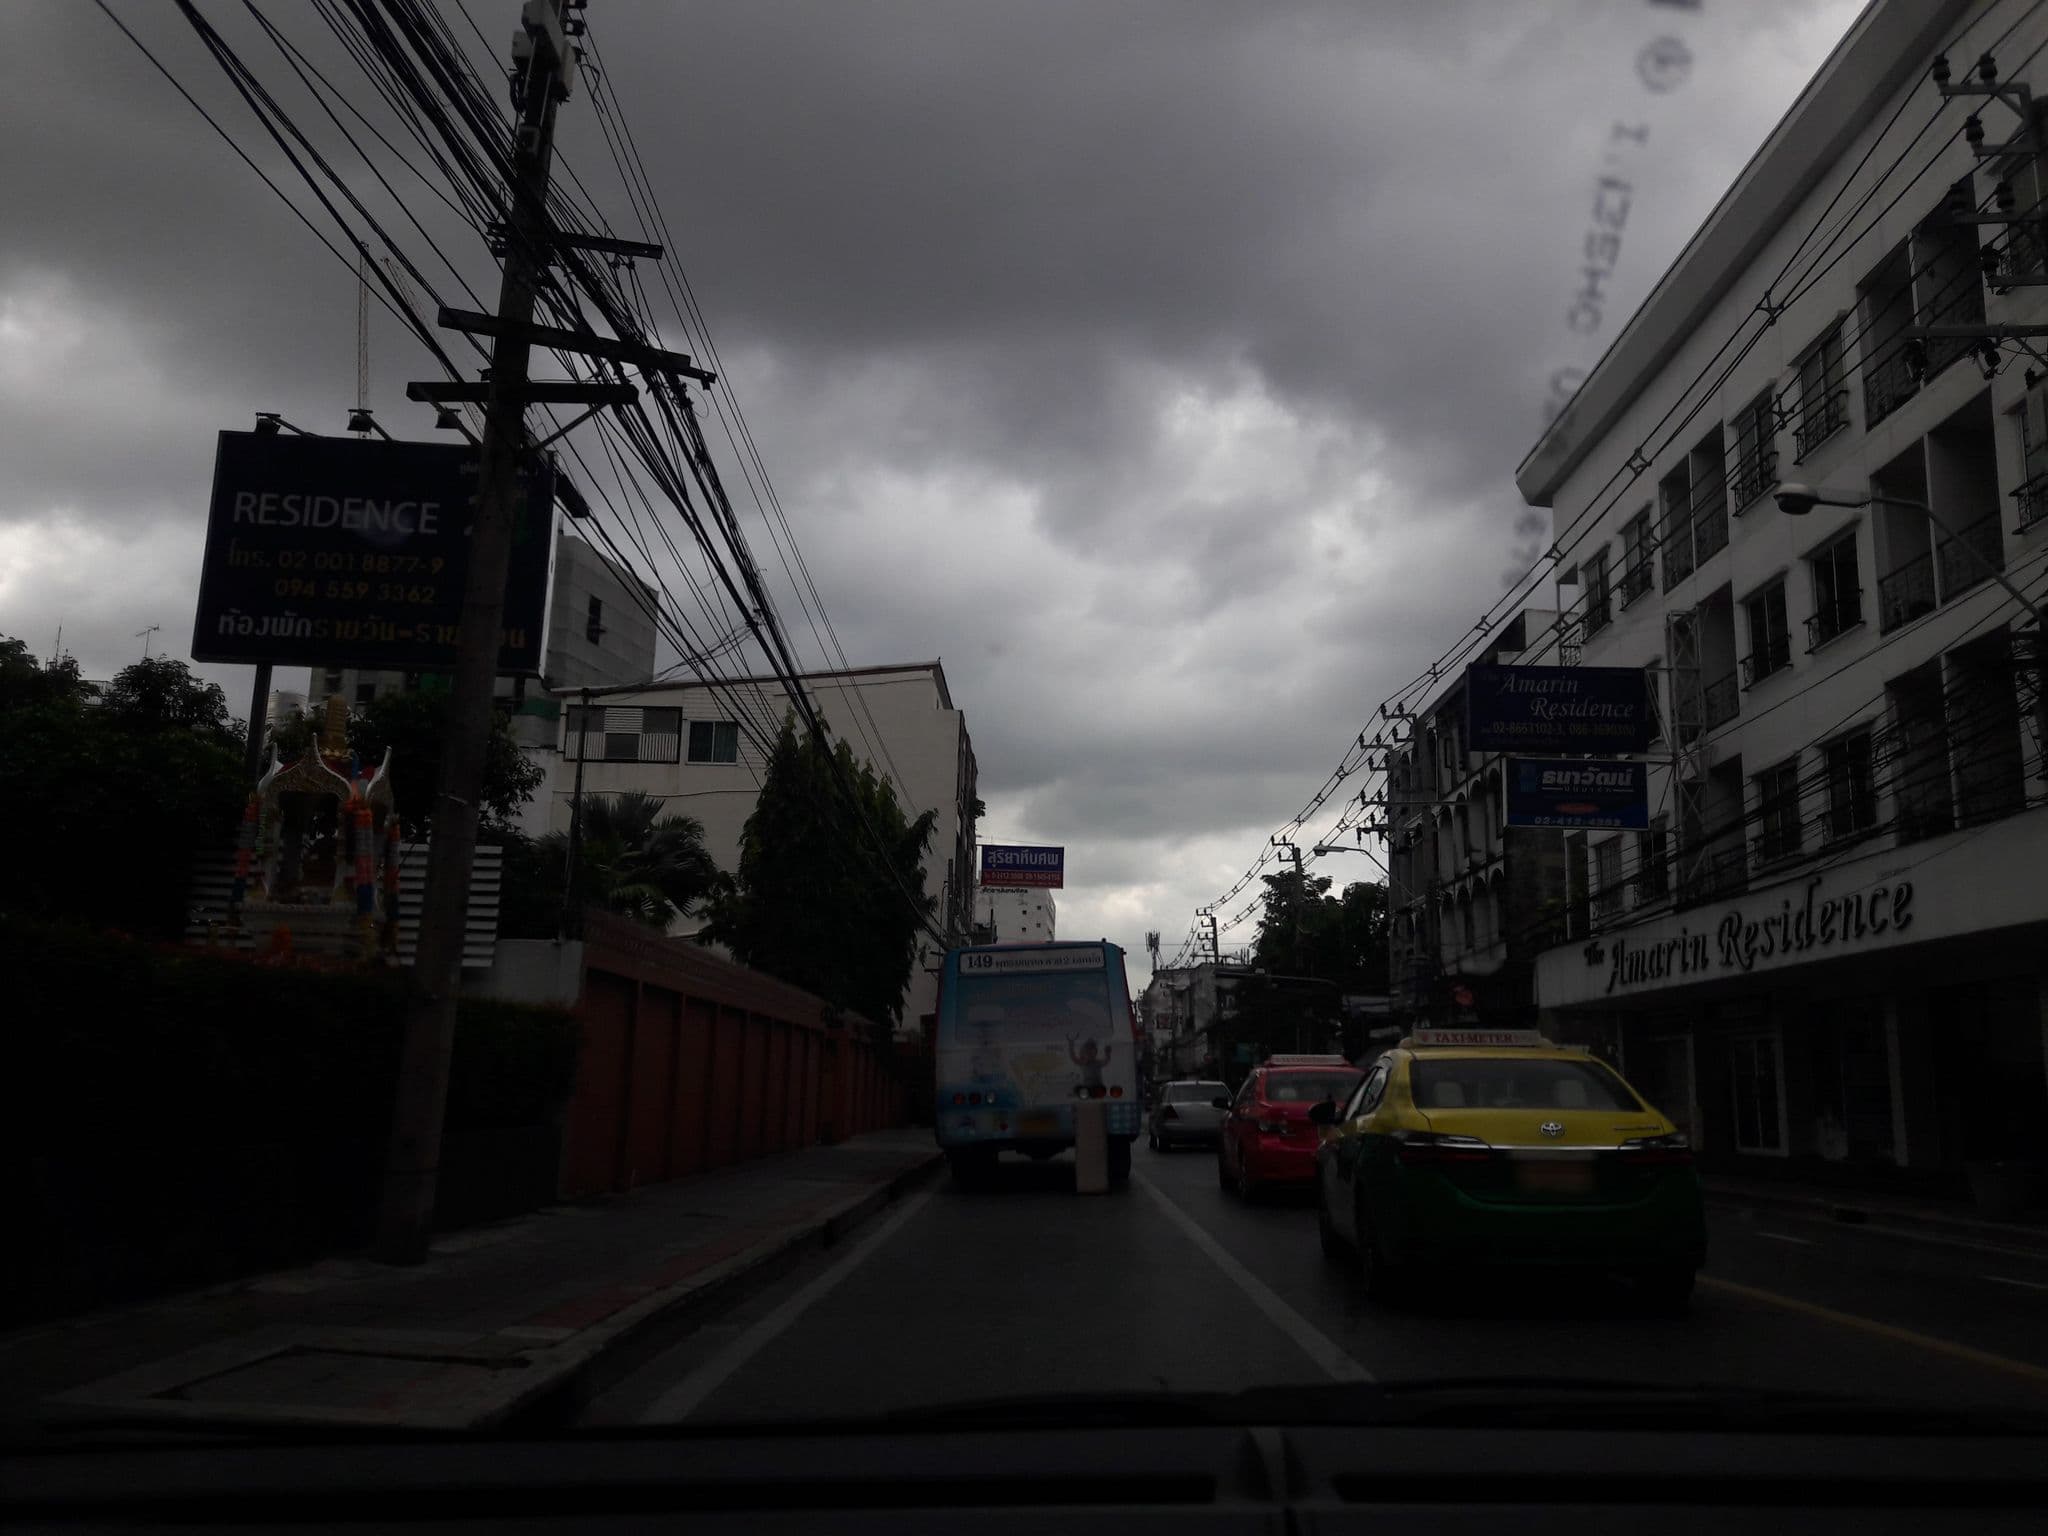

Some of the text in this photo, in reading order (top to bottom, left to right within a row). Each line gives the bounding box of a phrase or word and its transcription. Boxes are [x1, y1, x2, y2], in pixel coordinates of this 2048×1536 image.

[233, 490, 441, 536] RESIDENCE
[226, 537, 271, 567] โทร.
[278, 551, 306, 569] 02
[314, 552, 354, 571] 001
[274, 576, 316, 600] 094
[326, 579, 369, 601] 559
[1497, 672, 1579, 696] Amarin
[1530, 697, 1633, 720] Residence
[1584, 876, 1914, 994] The Amarin Residence
[967, 954, 993, 970] 149
